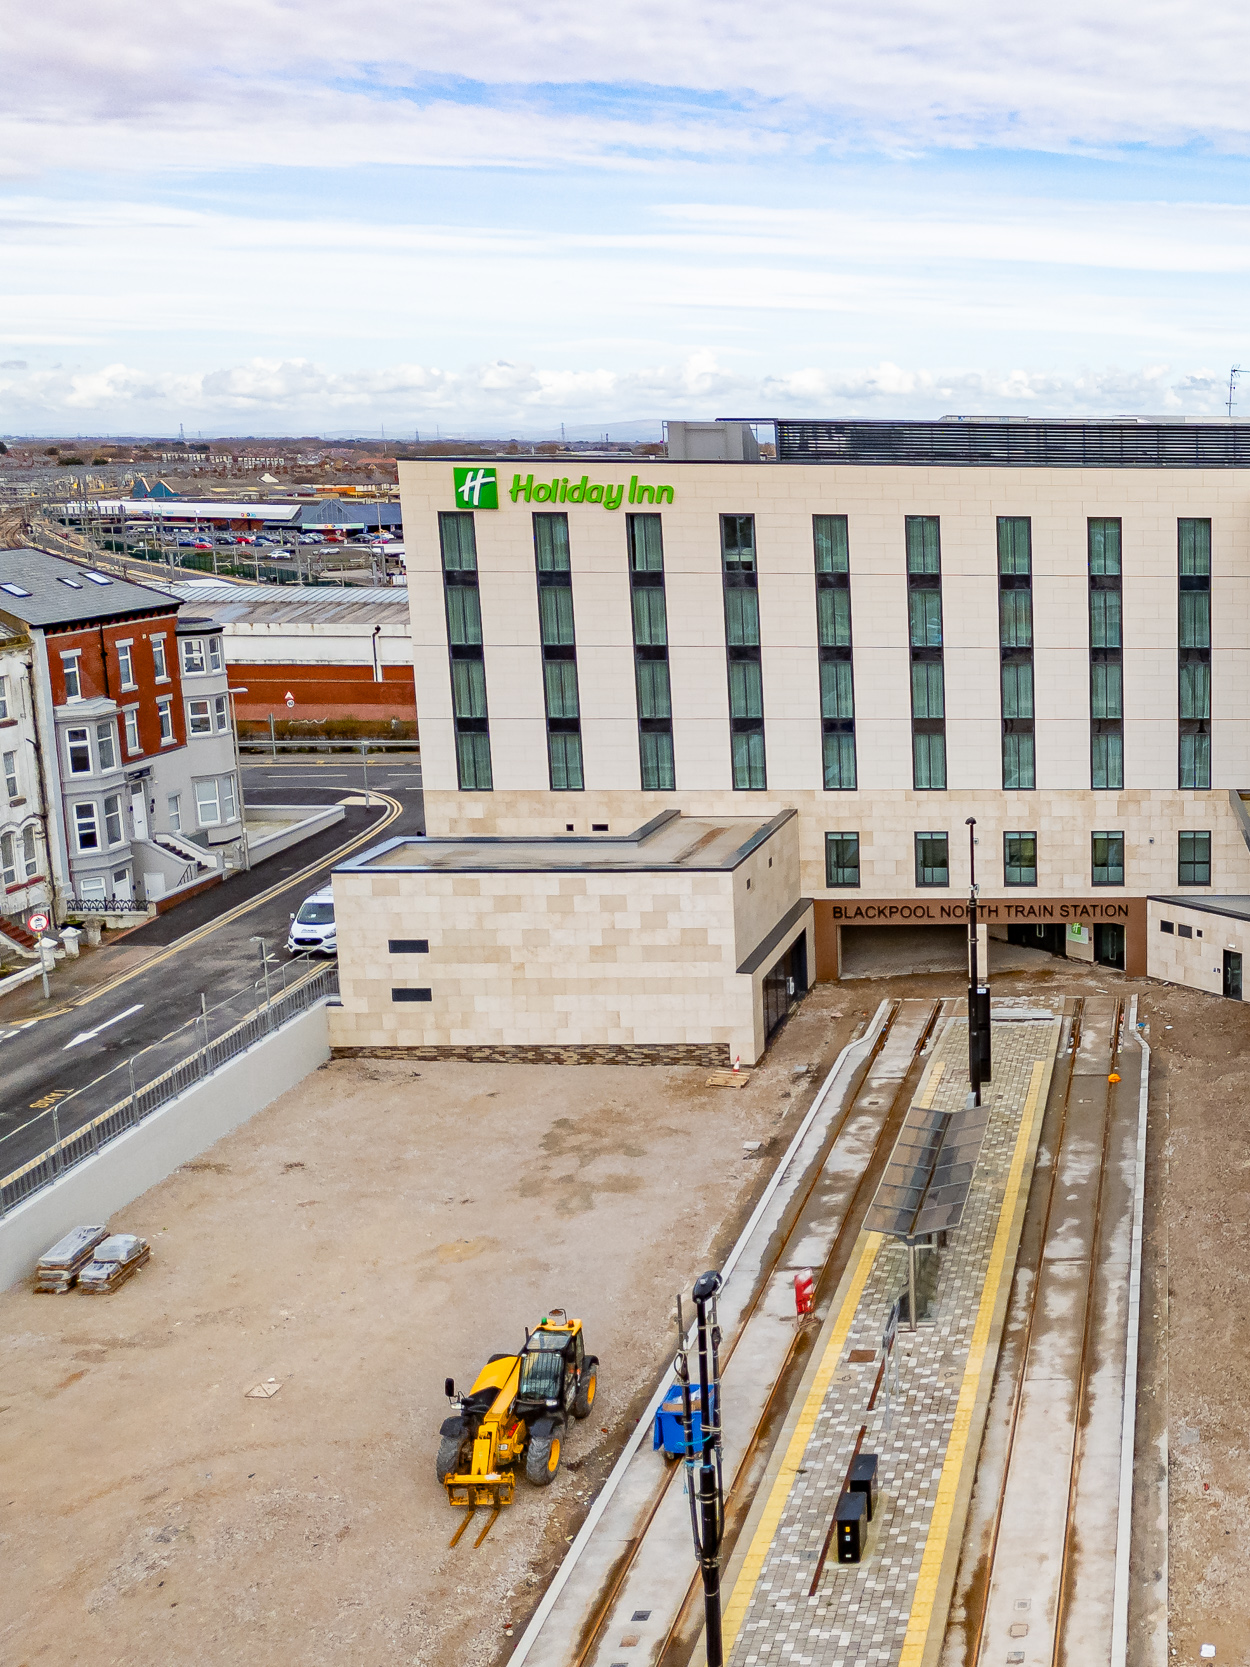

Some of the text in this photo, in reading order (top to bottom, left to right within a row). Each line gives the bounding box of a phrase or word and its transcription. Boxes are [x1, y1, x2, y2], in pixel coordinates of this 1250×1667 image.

[509, 473, 674, 510] Holiday Inn
[832, 903, 1129, 919] BLACKPOOL NOTH TRAIN STATION
